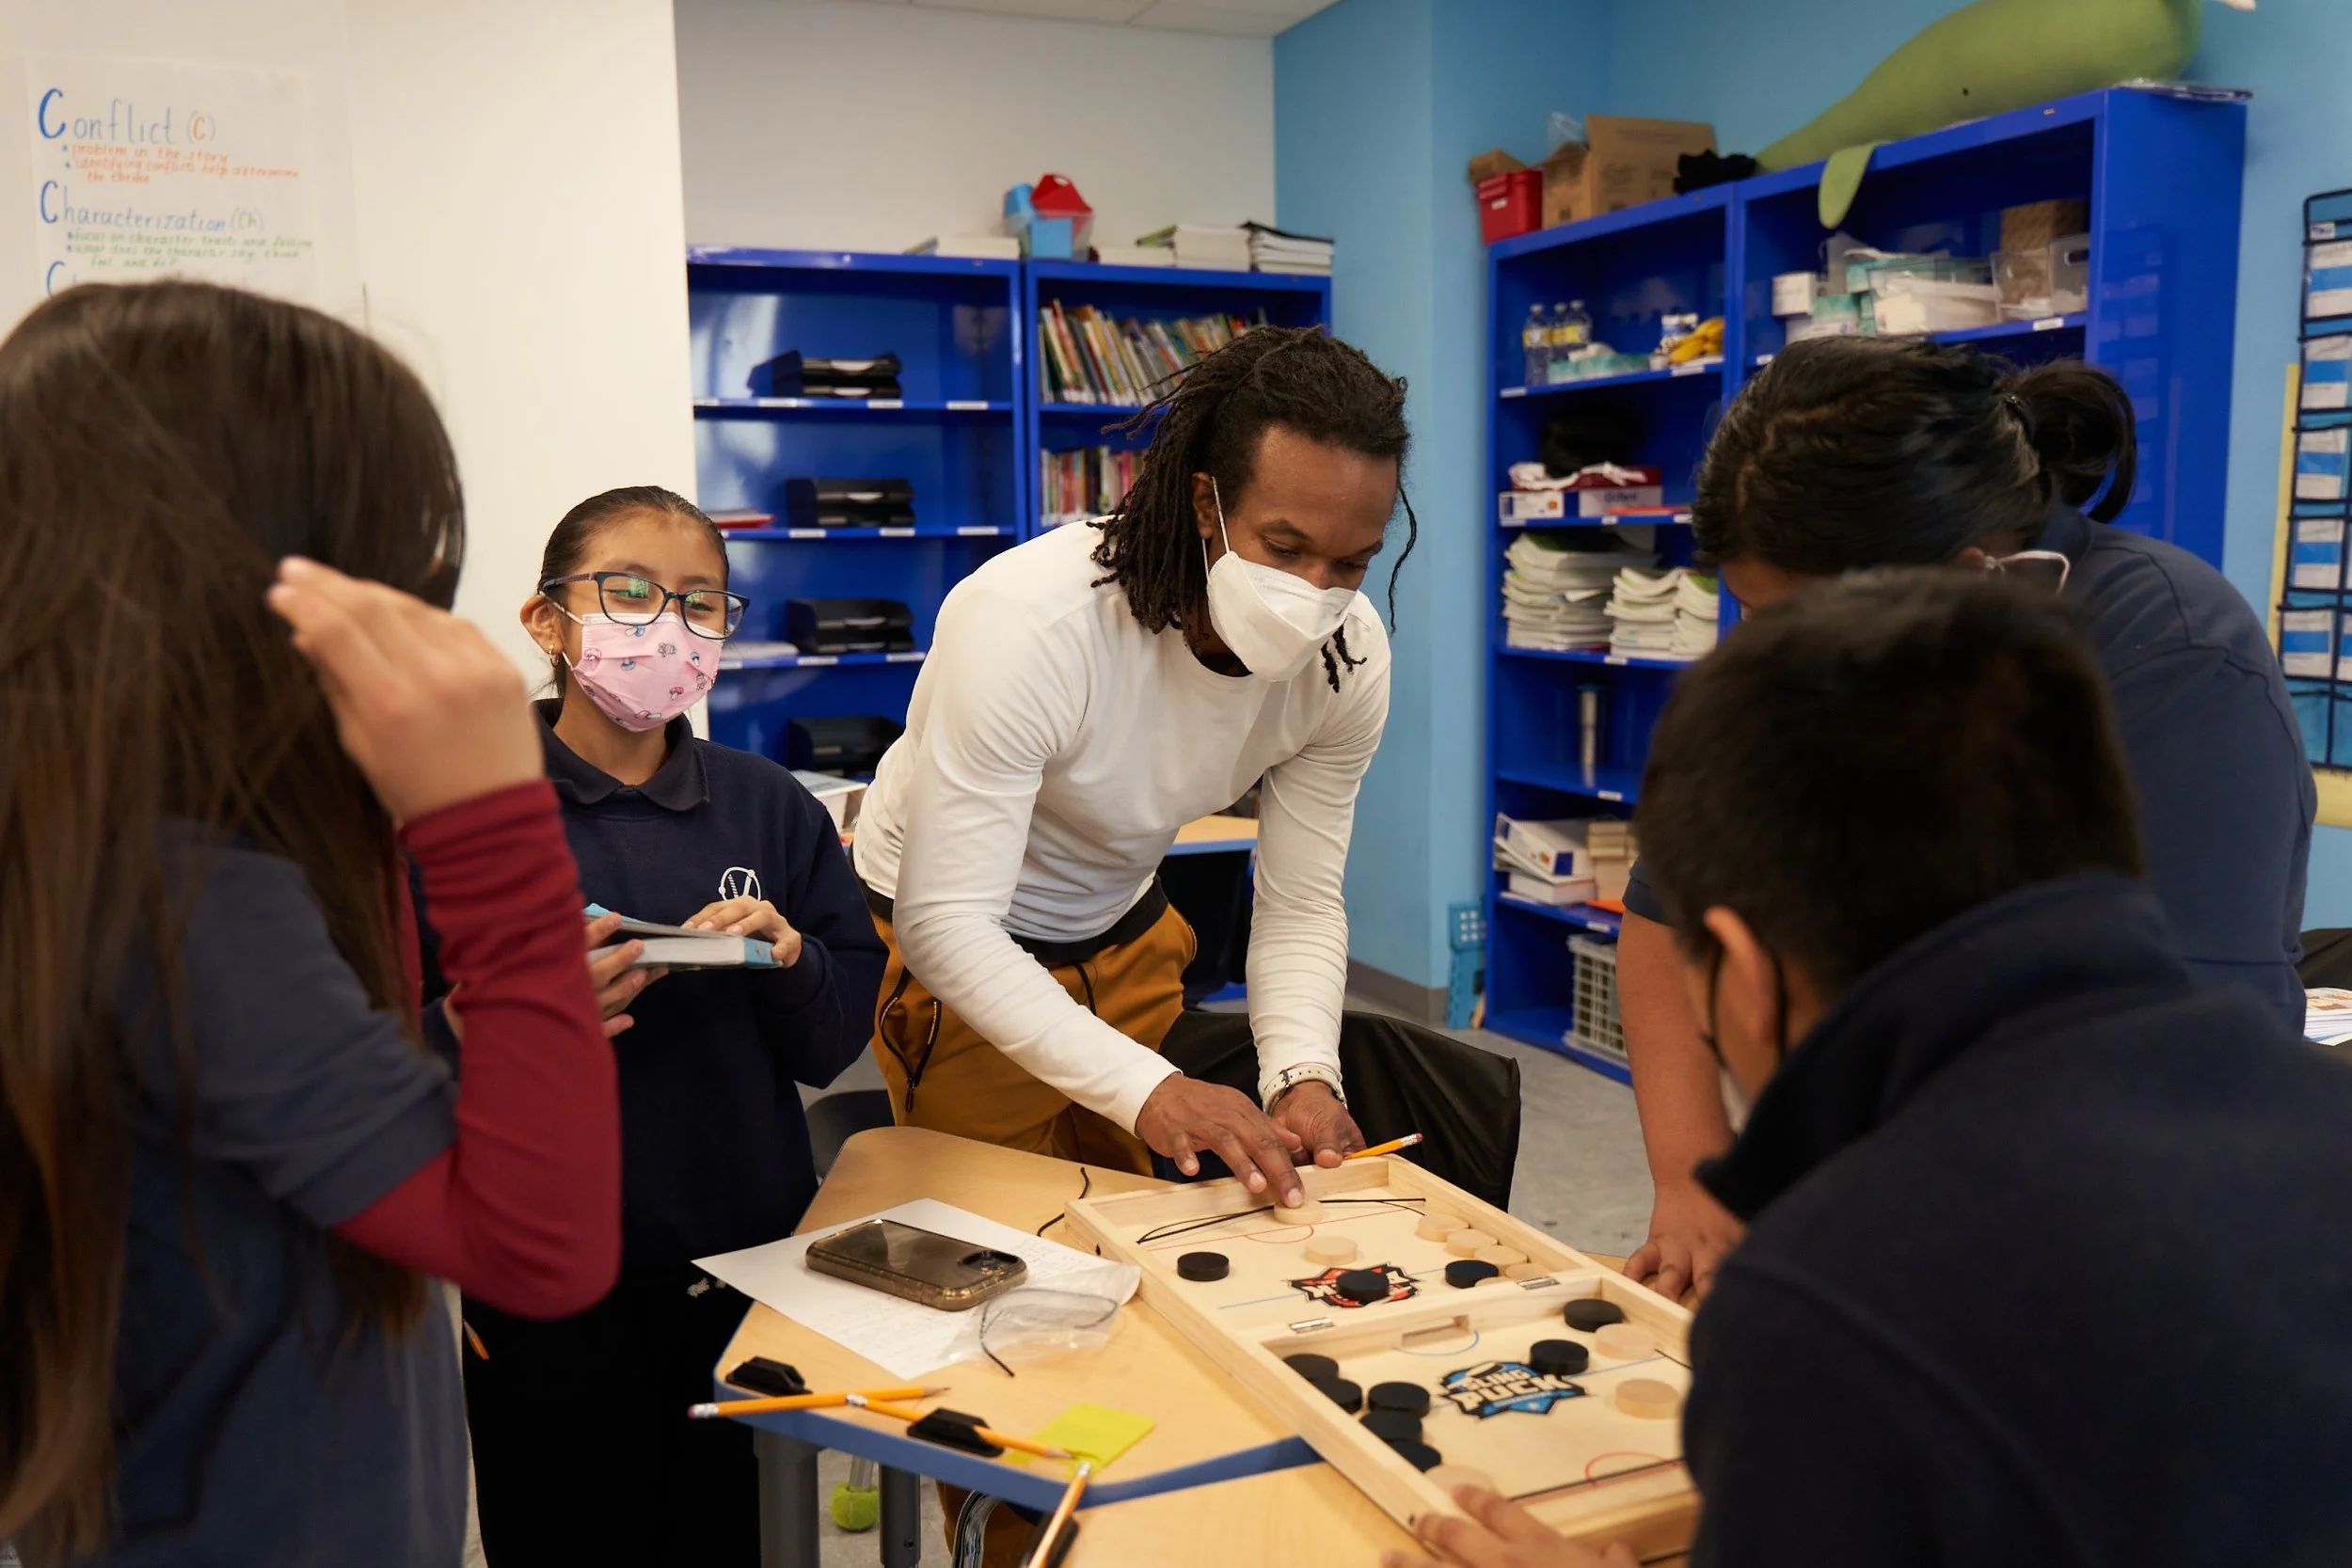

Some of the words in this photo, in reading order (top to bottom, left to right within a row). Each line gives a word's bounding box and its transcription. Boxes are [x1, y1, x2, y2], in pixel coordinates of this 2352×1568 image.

[39, 88, 173, 145] Conflict
[40, 181, 226, 231] Characterization
[1449, 1374, 1575, 1411] PUCK
